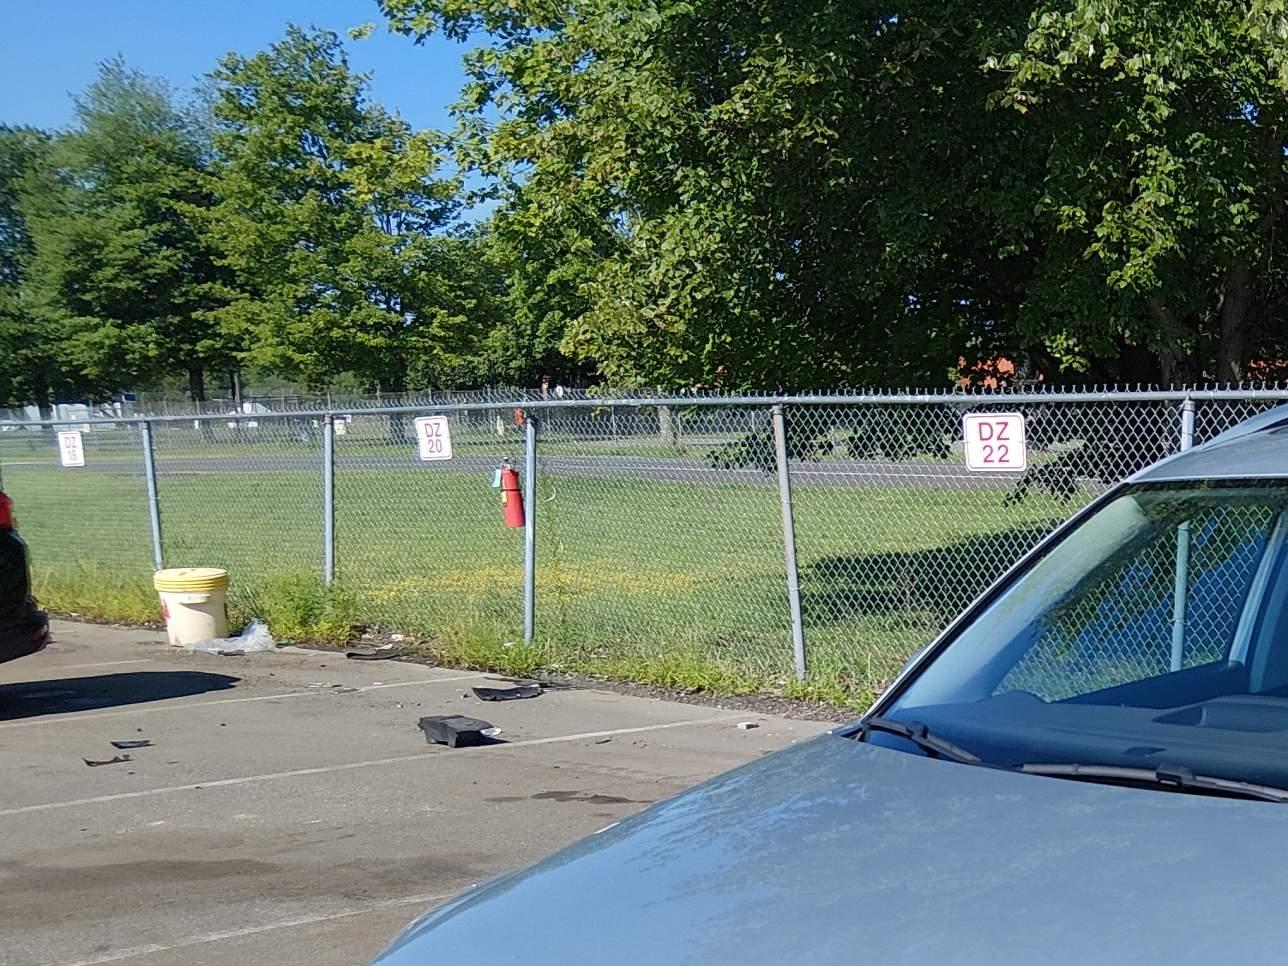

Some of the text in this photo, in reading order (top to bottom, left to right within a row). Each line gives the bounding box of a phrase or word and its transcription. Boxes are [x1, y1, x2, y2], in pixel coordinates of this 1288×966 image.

[424, 422, 443, 438] DZ
[978, 421, 1010, 442] DZ
[64, 436, 78, 449] DZ
[427, 438, 443, 454] 20
[982, 444, 1010, 464] 22
